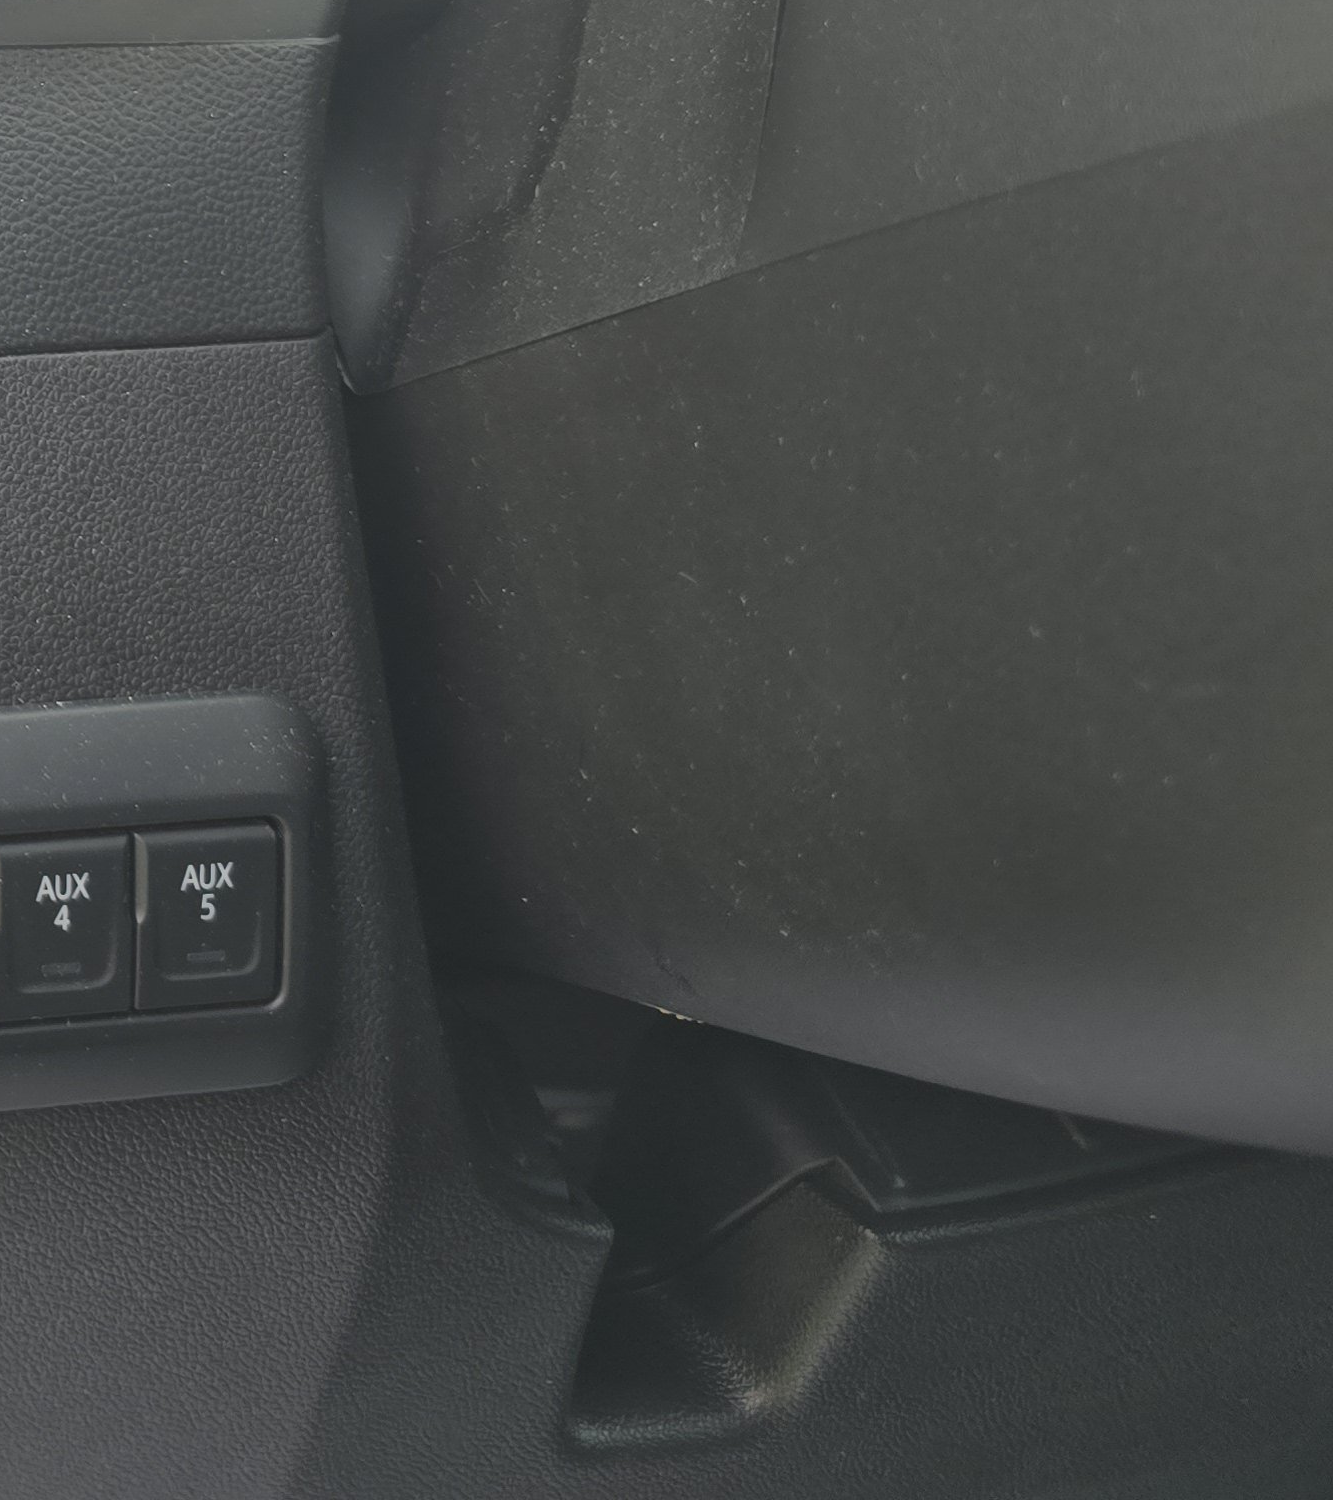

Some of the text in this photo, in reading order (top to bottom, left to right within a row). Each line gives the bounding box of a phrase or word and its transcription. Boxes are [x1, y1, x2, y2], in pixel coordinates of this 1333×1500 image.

[35, 871, 91, 903] AUX
[180, 861, 235, 892] AUX
[52, 904, 72, 932] 4
[200, 893, 217, 922] 5
